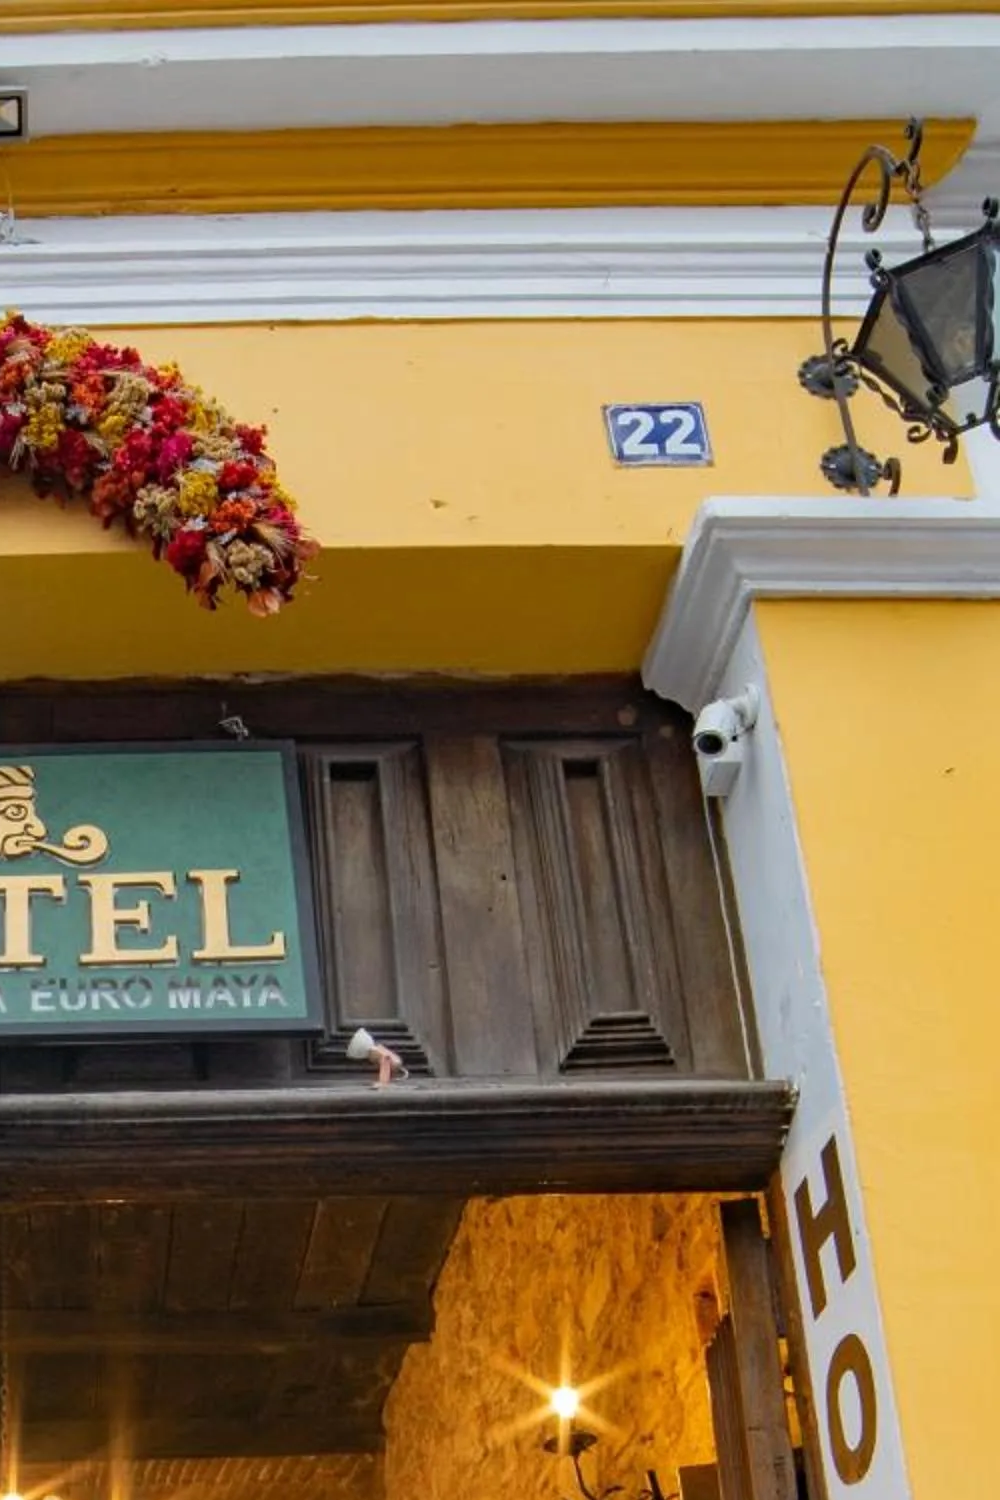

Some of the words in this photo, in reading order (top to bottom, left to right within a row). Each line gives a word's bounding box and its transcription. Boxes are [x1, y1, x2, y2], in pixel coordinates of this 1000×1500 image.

[617, 409, 701, 455] 22
[29, 974, 153, 1012] EURO
[167, 972, 288, 1010] MAYA
